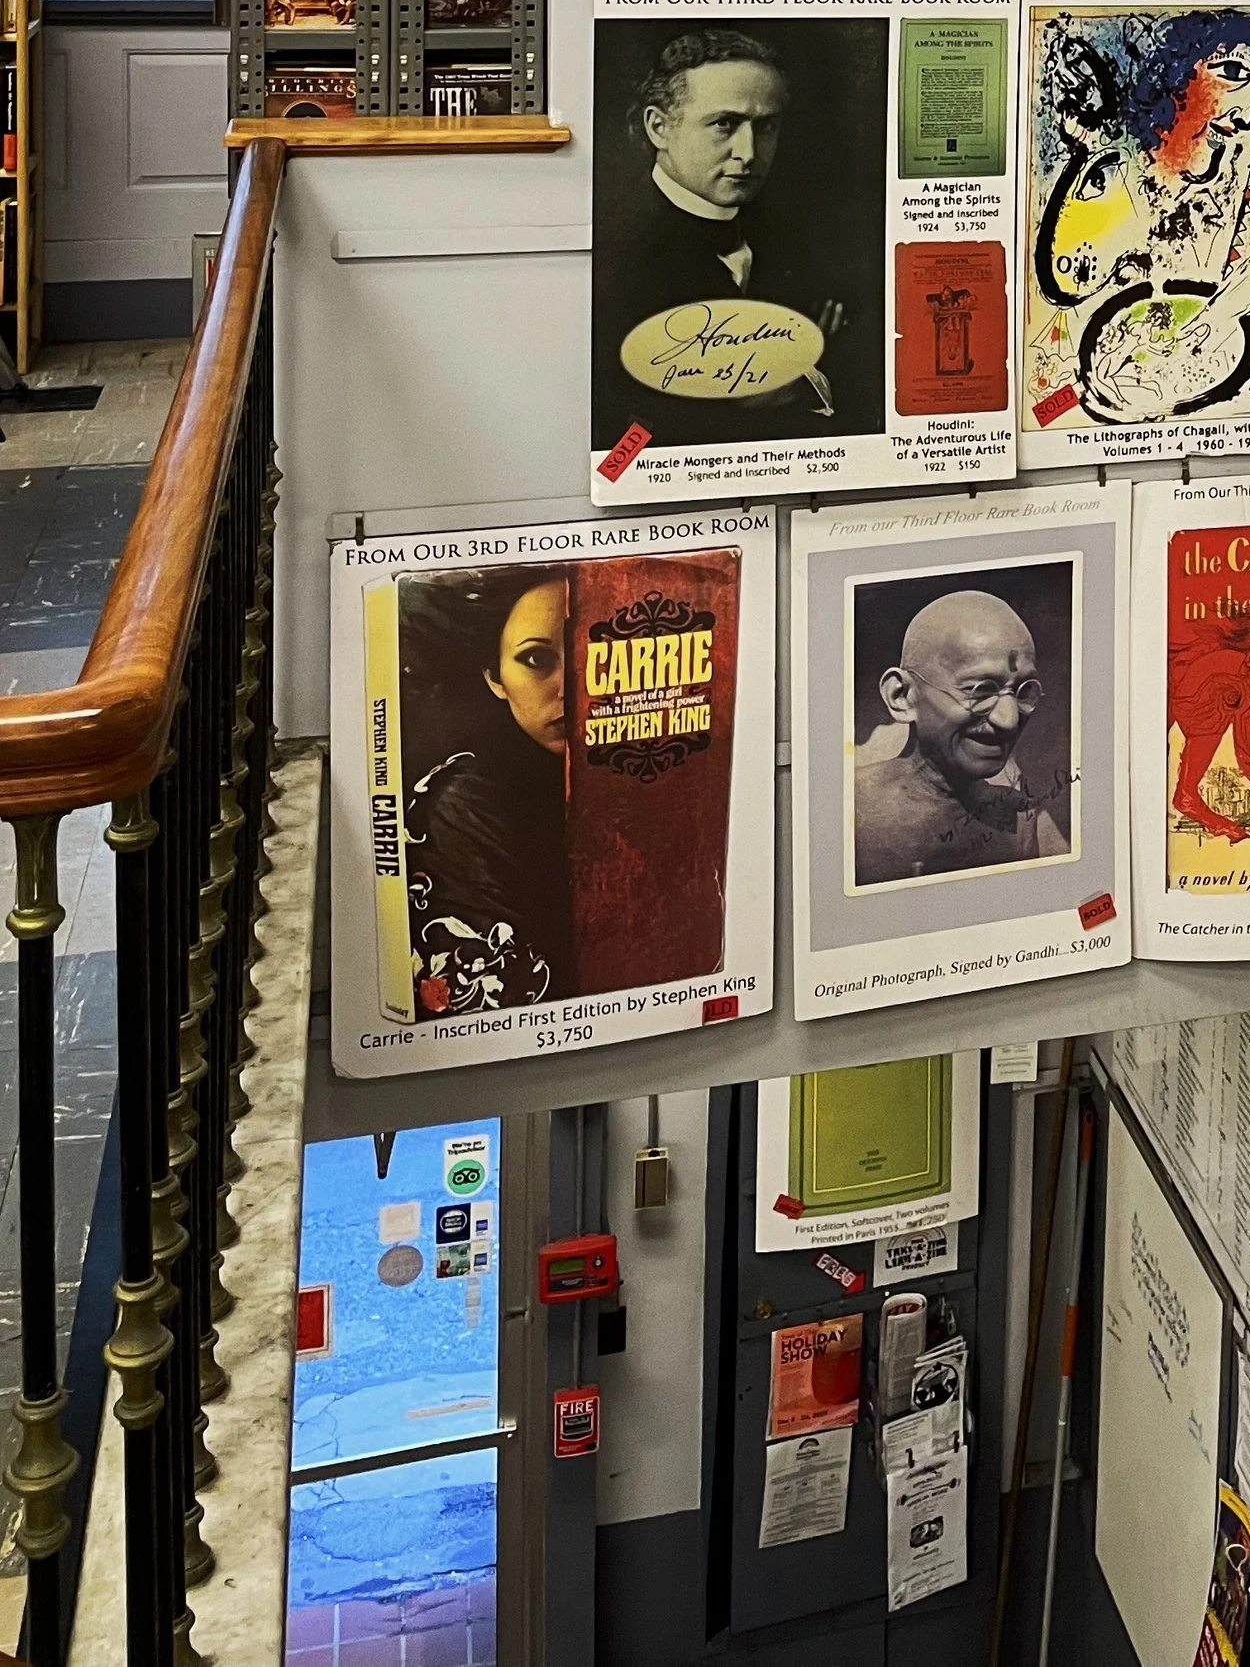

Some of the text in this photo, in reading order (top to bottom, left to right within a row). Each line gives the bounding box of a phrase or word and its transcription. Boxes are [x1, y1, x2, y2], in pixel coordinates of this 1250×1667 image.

[922, 182, 981, 194] A Magician
[902, 195, 1000, 207] Among the Spirits
[1067, 434, 1089, 444] The
[1094, 426, 1162, 442] Lithographs
[1168, 427, 1179, 437] of
[1183, 424, 1229, 437] Chagall,
[1185, 542, 1221, 574] the
[1186, 597, 1205, 619] in
[586, 630, 712, 696] CARRIE
[585, 704, 710, 745] STEPHEN KING
[1179, 876, 1188, 889] a
[1193, 871, 1234, 885] novel
[815, 977, 867, 997] Original
[872, 965, 945, 987] Photograph,
[951, 955, 992, 975] Signed
[997, 954, 1011, 969] by
[360, 977, 755, 1049] Carrie Inscribed First Edition by Stephen King
[537, 1025, 592, 1048] $3,750
[781, 1329, 847, 1352] HOLIDAY
[781, 1346, 828, 1364] SHOW
[560, 1400, 595, 1416] FIRE
